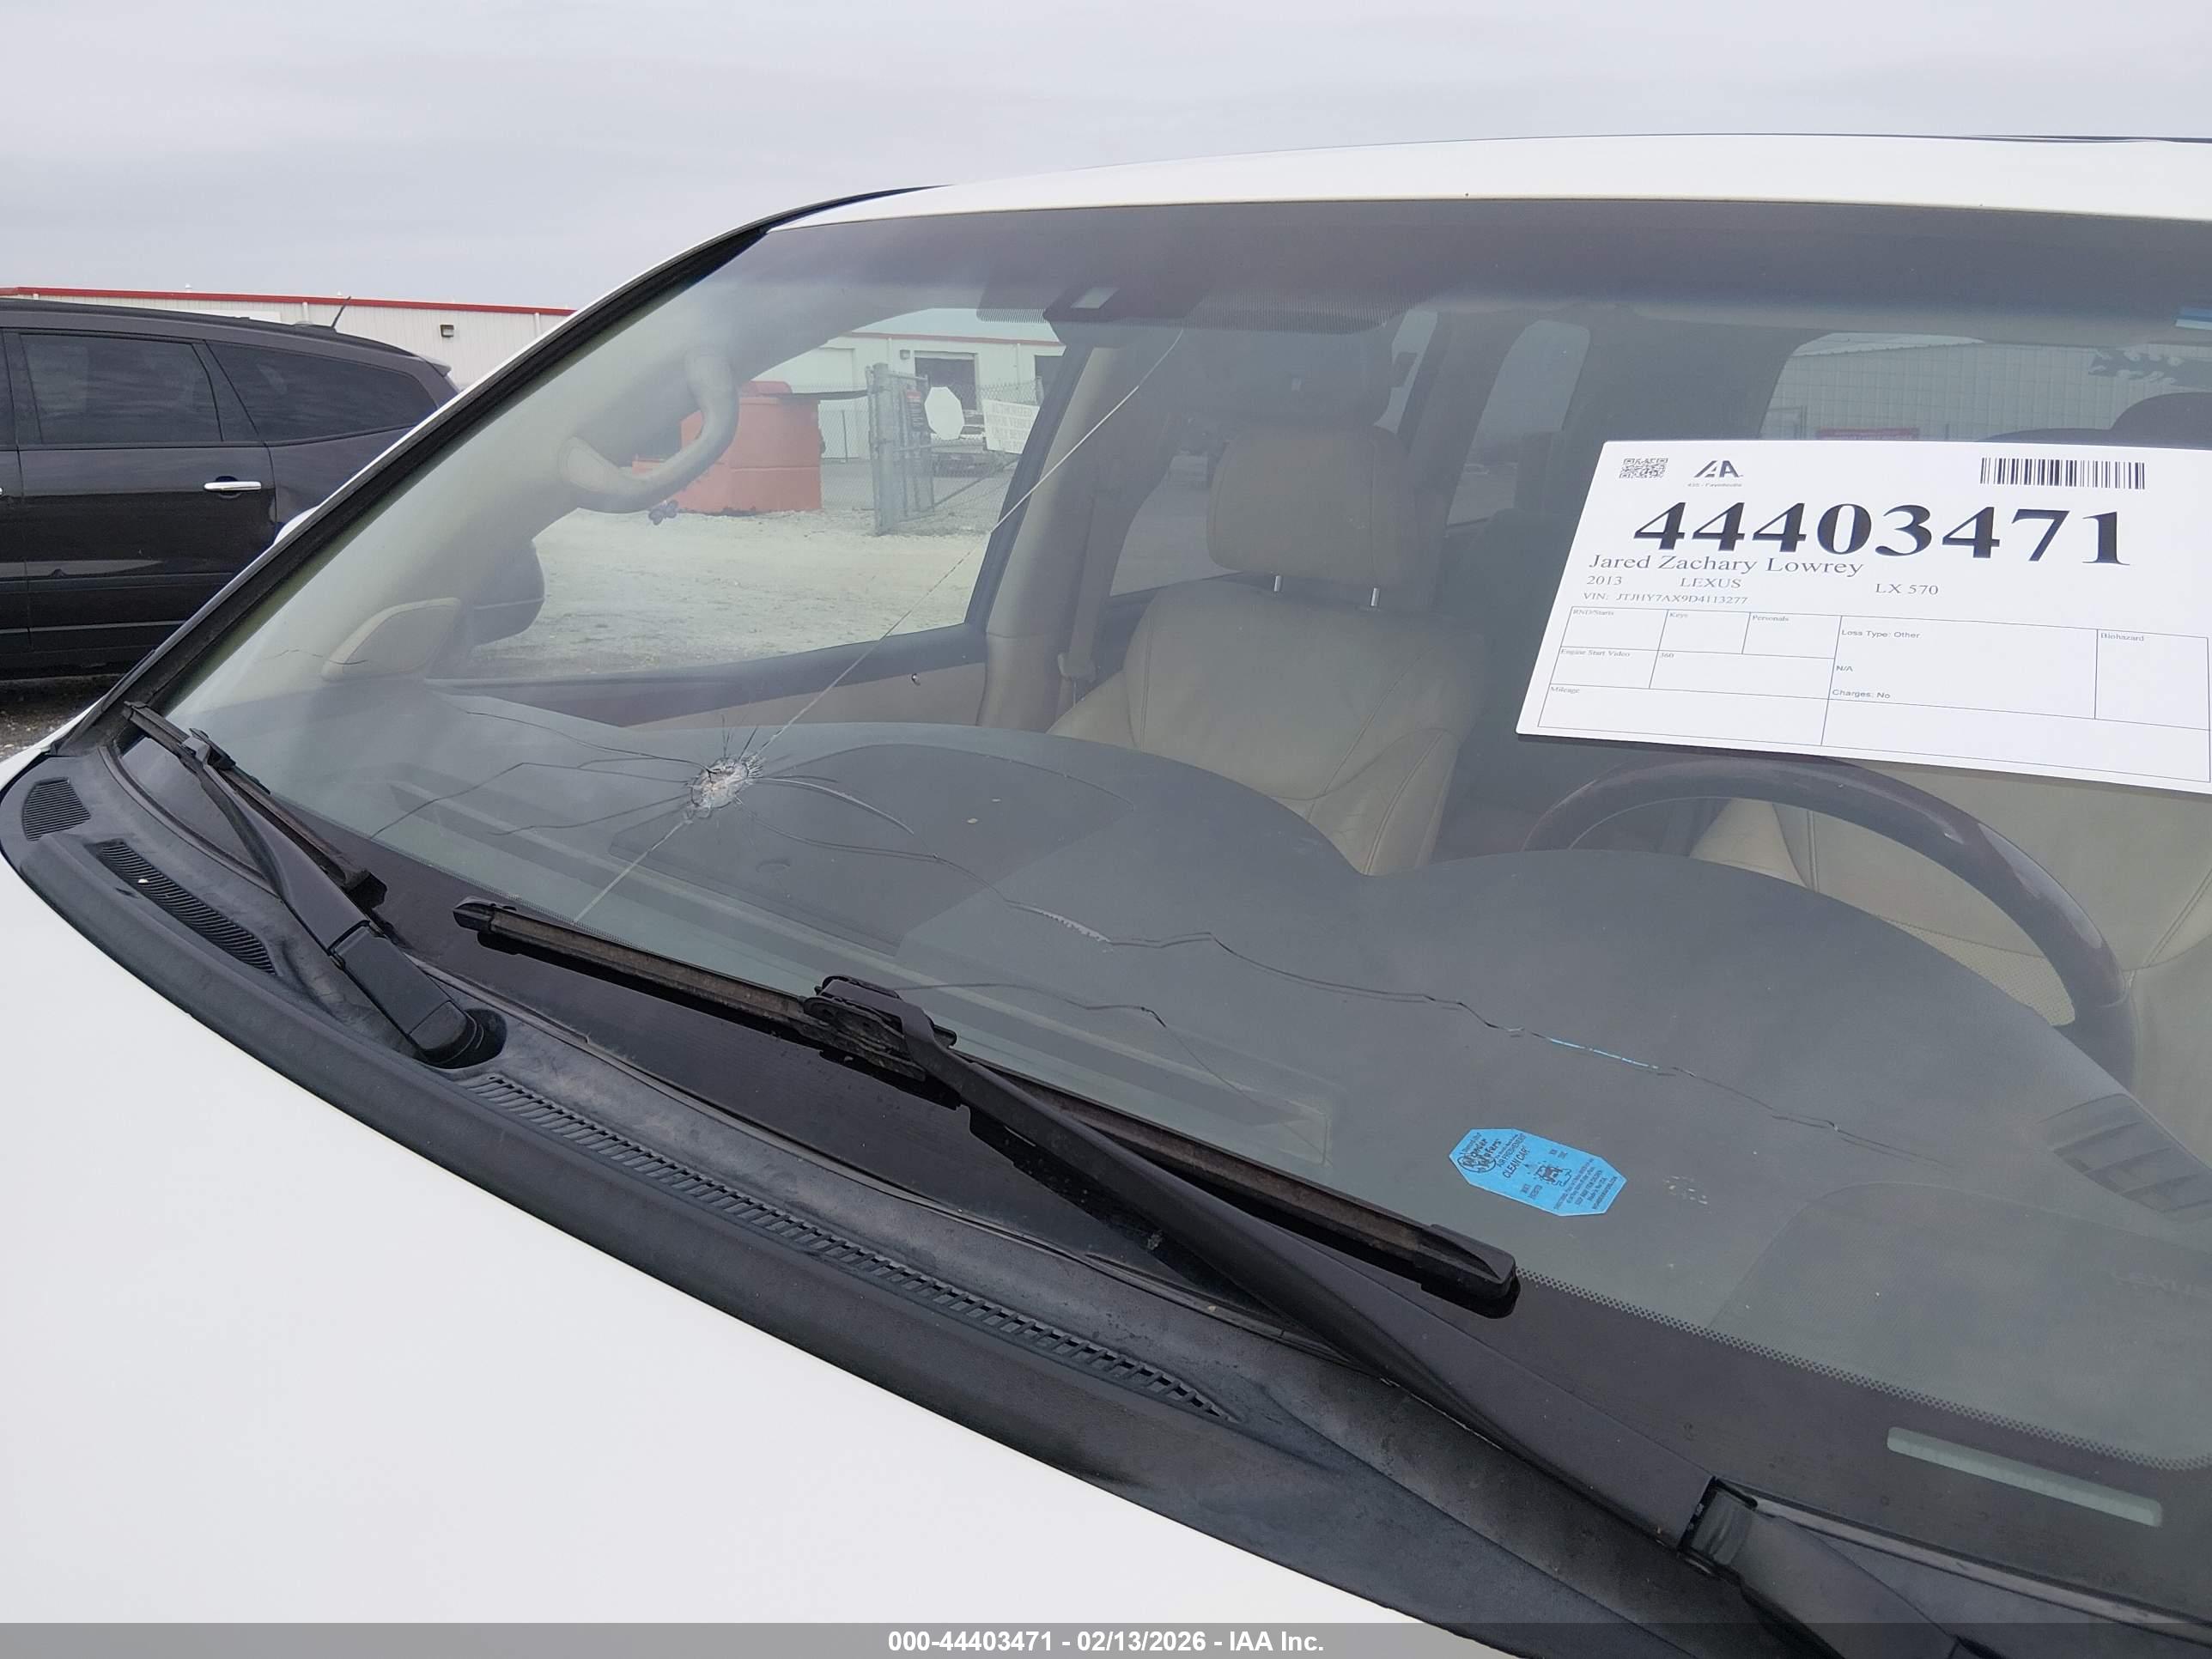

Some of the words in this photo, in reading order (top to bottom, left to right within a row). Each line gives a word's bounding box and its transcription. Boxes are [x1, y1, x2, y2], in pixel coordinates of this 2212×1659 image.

[1633, 501, 2130, 566] 44403471
[1589, 555, 1651, 569] Jared
[1658, 556, 1758, 574] Zachary
[1765, 557, 1864, 578] Lowrey
[1586, 576, 1622, 586] 2013
[1680, 577, 1742, 589] LEXUS
[1875, 583, 1903, 594] LX
[1907, 585, 1939, 596] 570
[1583, 592, 1608, 601] VIN:
[1866, 630, 1891, 639] Type:
[2100, 632, 2145, 642] Biohazard
[1832, 689, 1875, 699] Charges:
[1502, 1158, 1522, 1179] CLEAN
